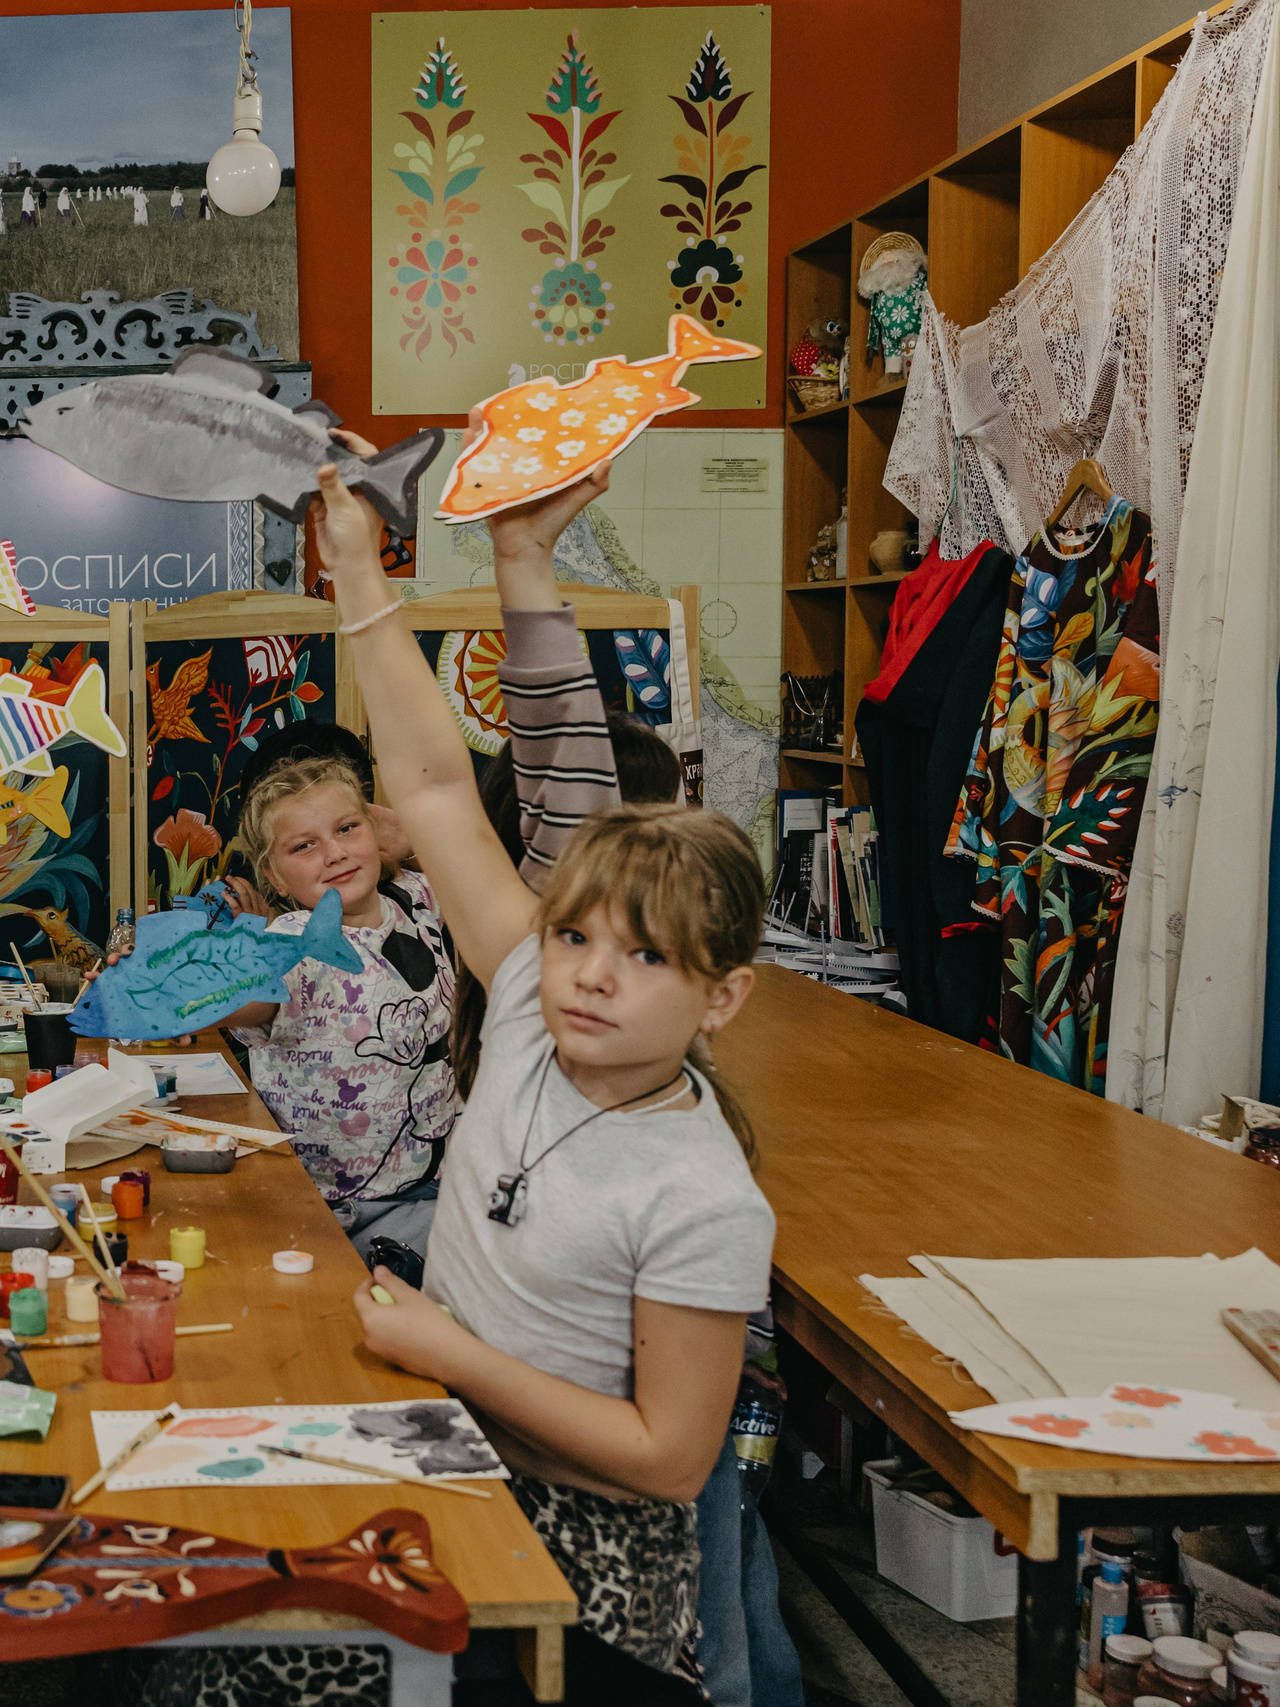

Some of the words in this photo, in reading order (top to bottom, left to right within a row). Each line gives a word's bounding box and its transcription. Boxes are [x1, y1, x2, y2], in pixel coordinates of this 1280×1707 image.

[529, 363, 585, 380] РОСП
[15, 553, 217, 592] ОСПИСИ
[321, 991, 336, 1010] be
[310, 1089, 326, 1105] be
[330, 1099, 368, 1112] mine
[729, 1416, 776, 1435] Active
